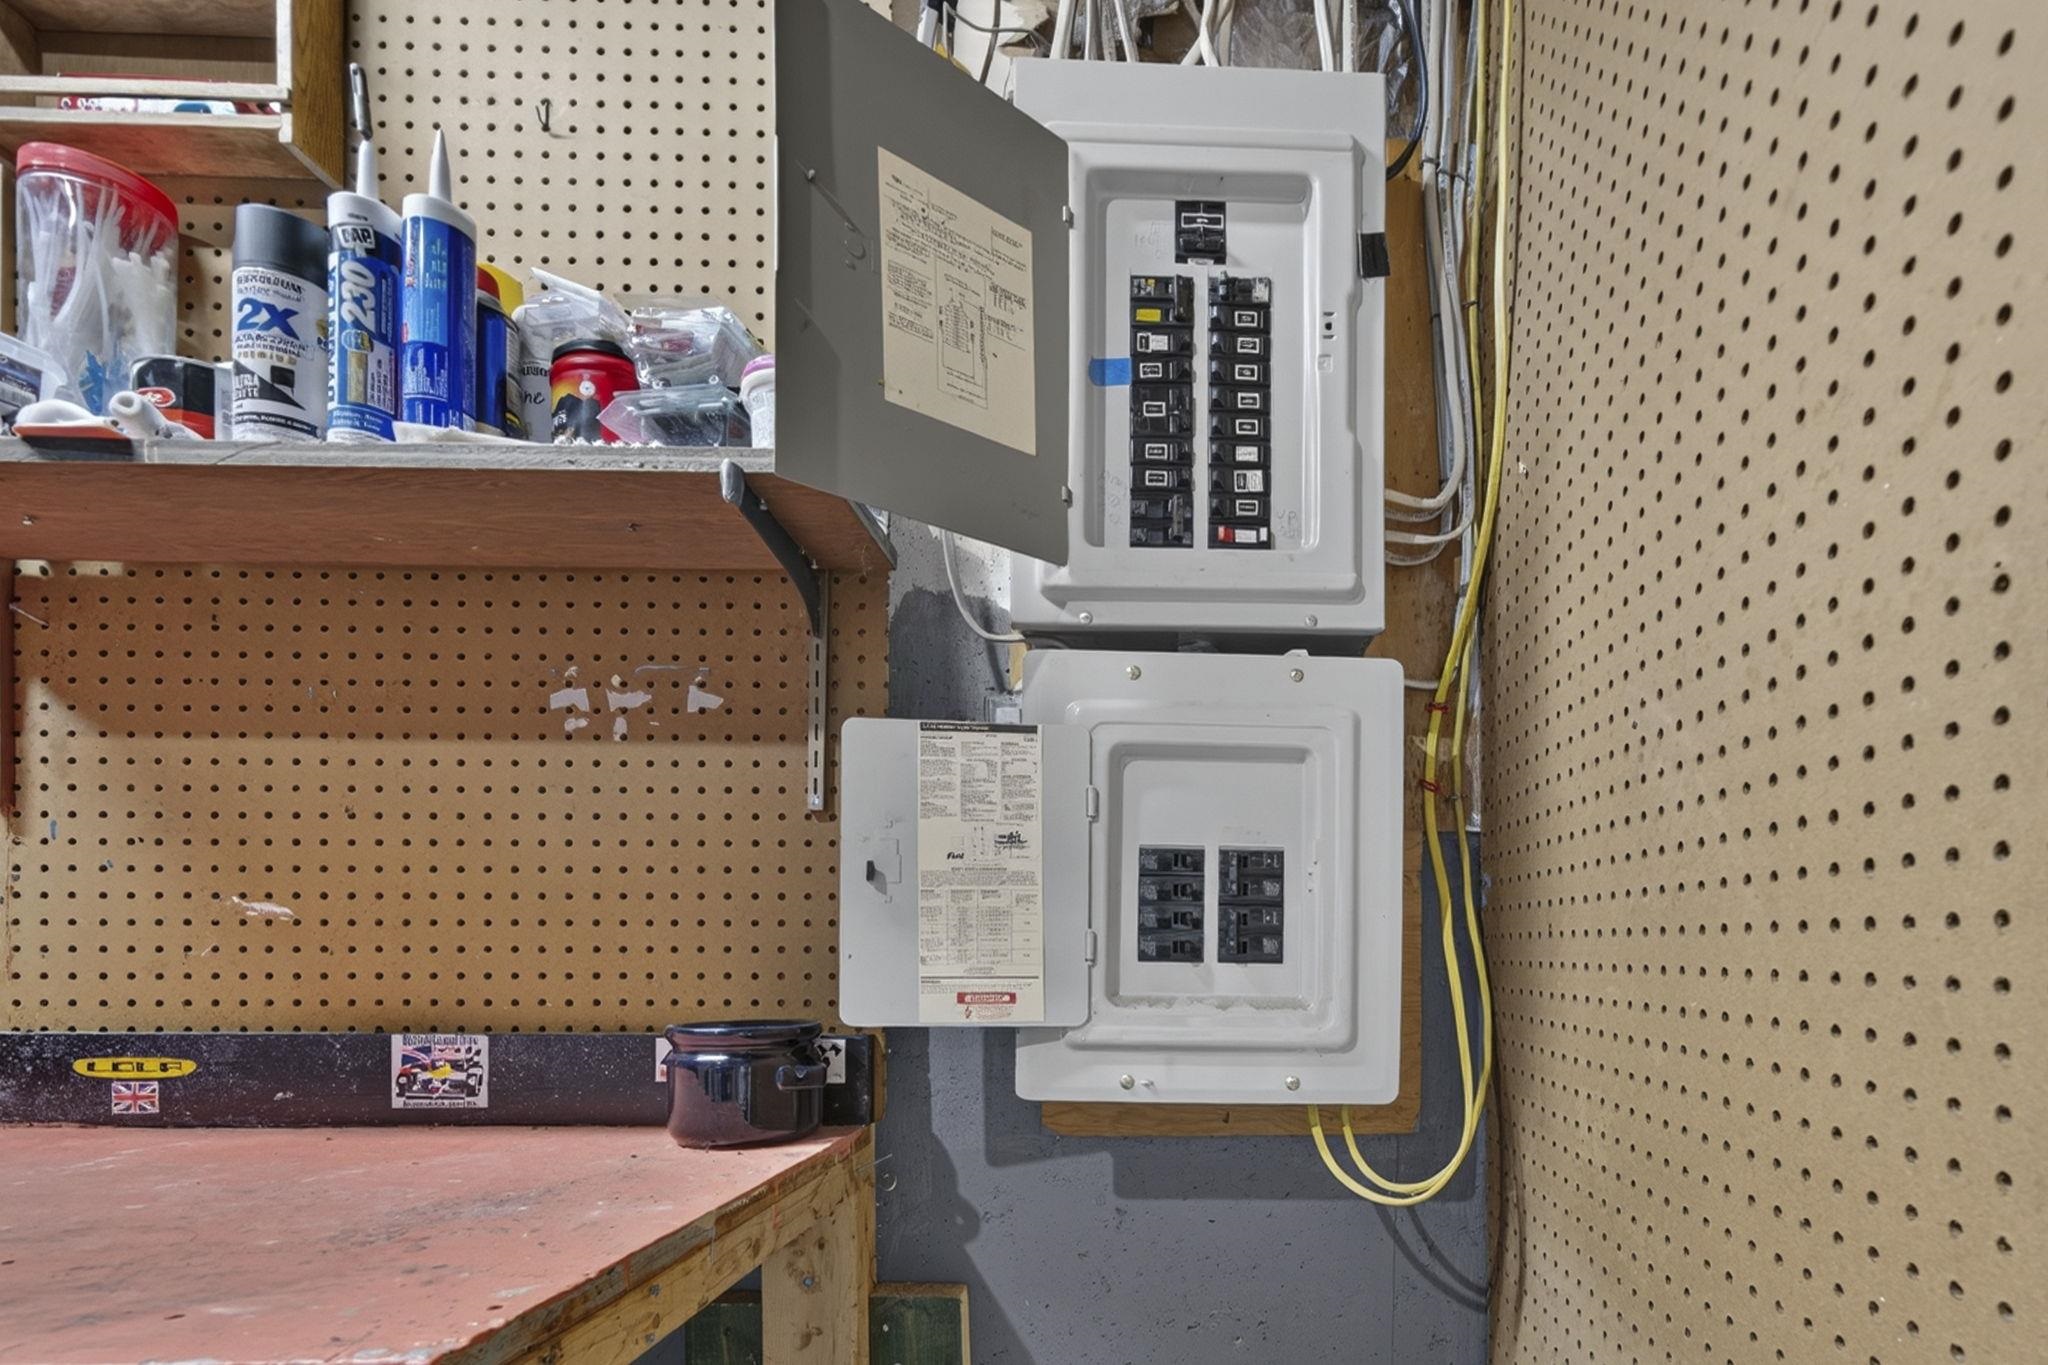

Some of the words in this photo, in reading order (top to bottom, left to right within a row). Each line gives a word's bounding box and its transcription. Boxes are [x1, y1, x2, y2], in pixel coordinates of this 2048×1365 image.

[341, 227, 372, 244] DAP
[341, 260, 376, 333] 230
[237, 297, 300, 341] 2X
